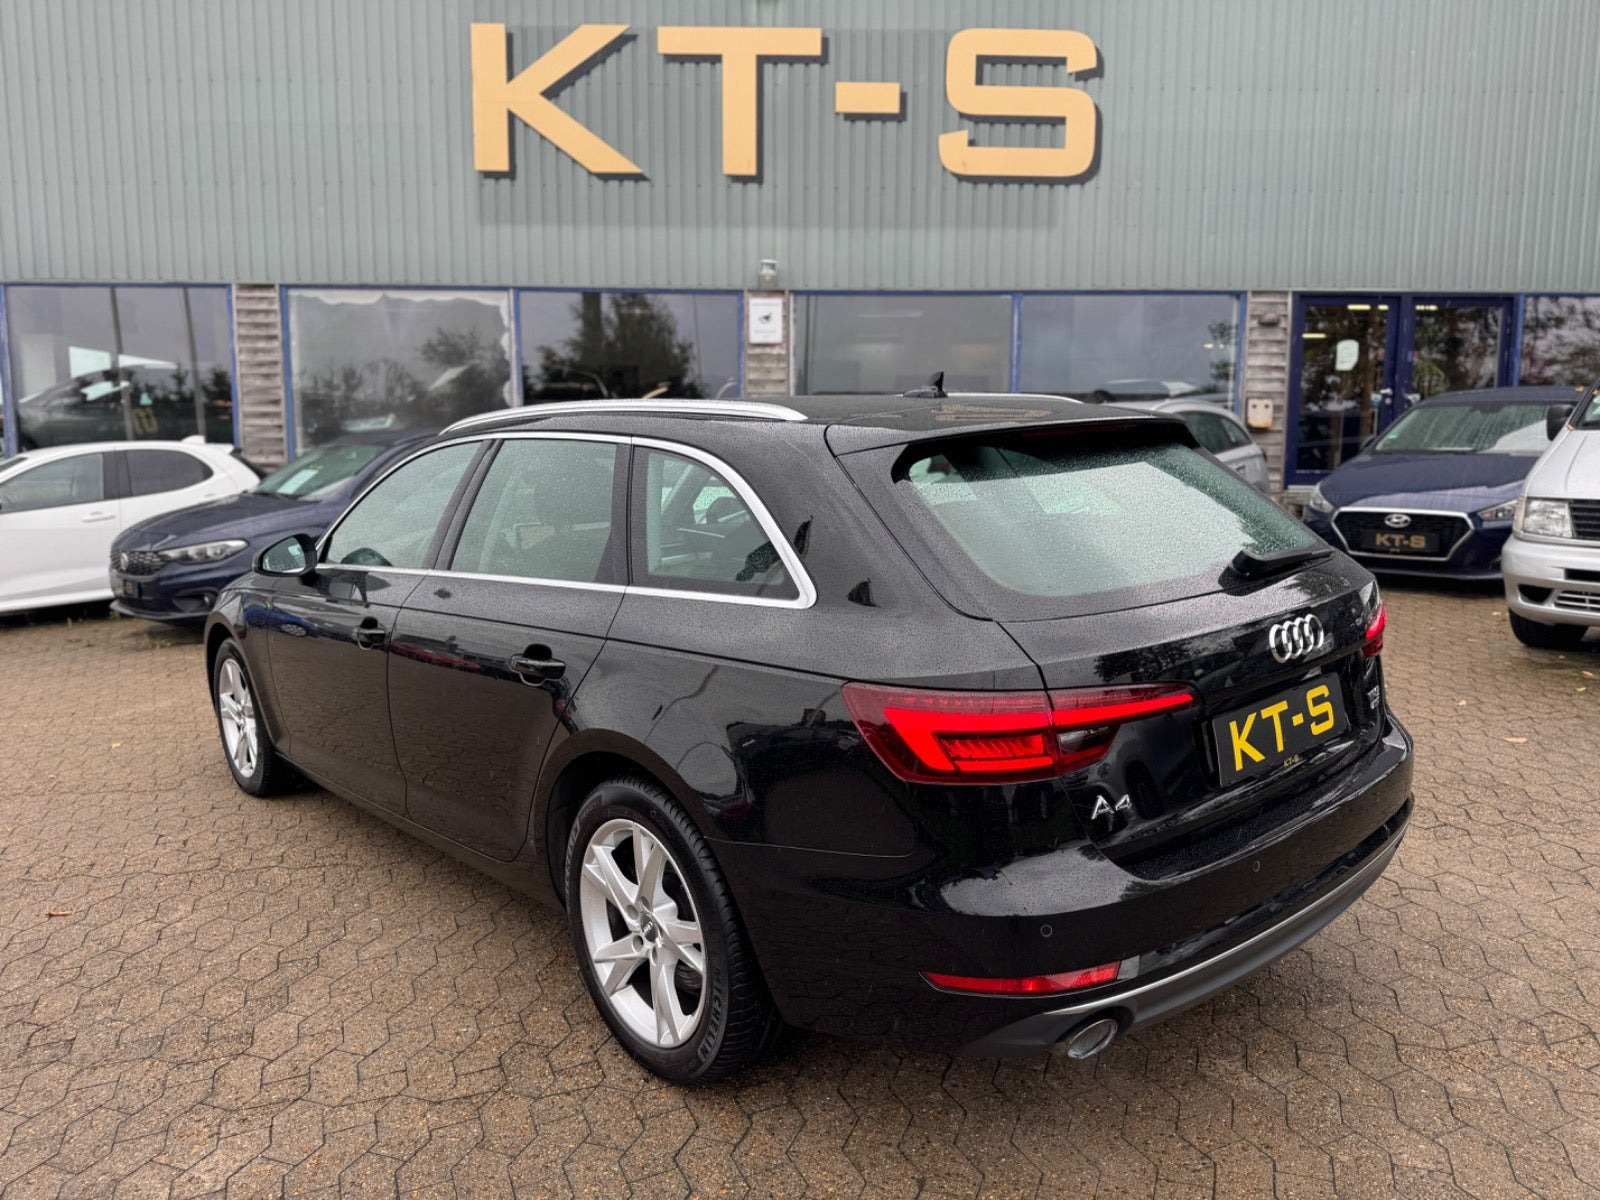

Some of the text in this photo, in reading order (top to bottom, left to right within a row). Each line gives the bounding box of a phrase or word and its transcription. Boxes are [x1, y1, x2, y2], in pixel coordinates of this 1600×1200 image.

[470, 23, 1098, 177] KT-S
[1375, 533, 1426, 548] KT-S
[1228, 684, 1335, 772] KT-S
[1091, 794, 1133, 820] A4
[699, 966, 722, 1058] MICHELIN
